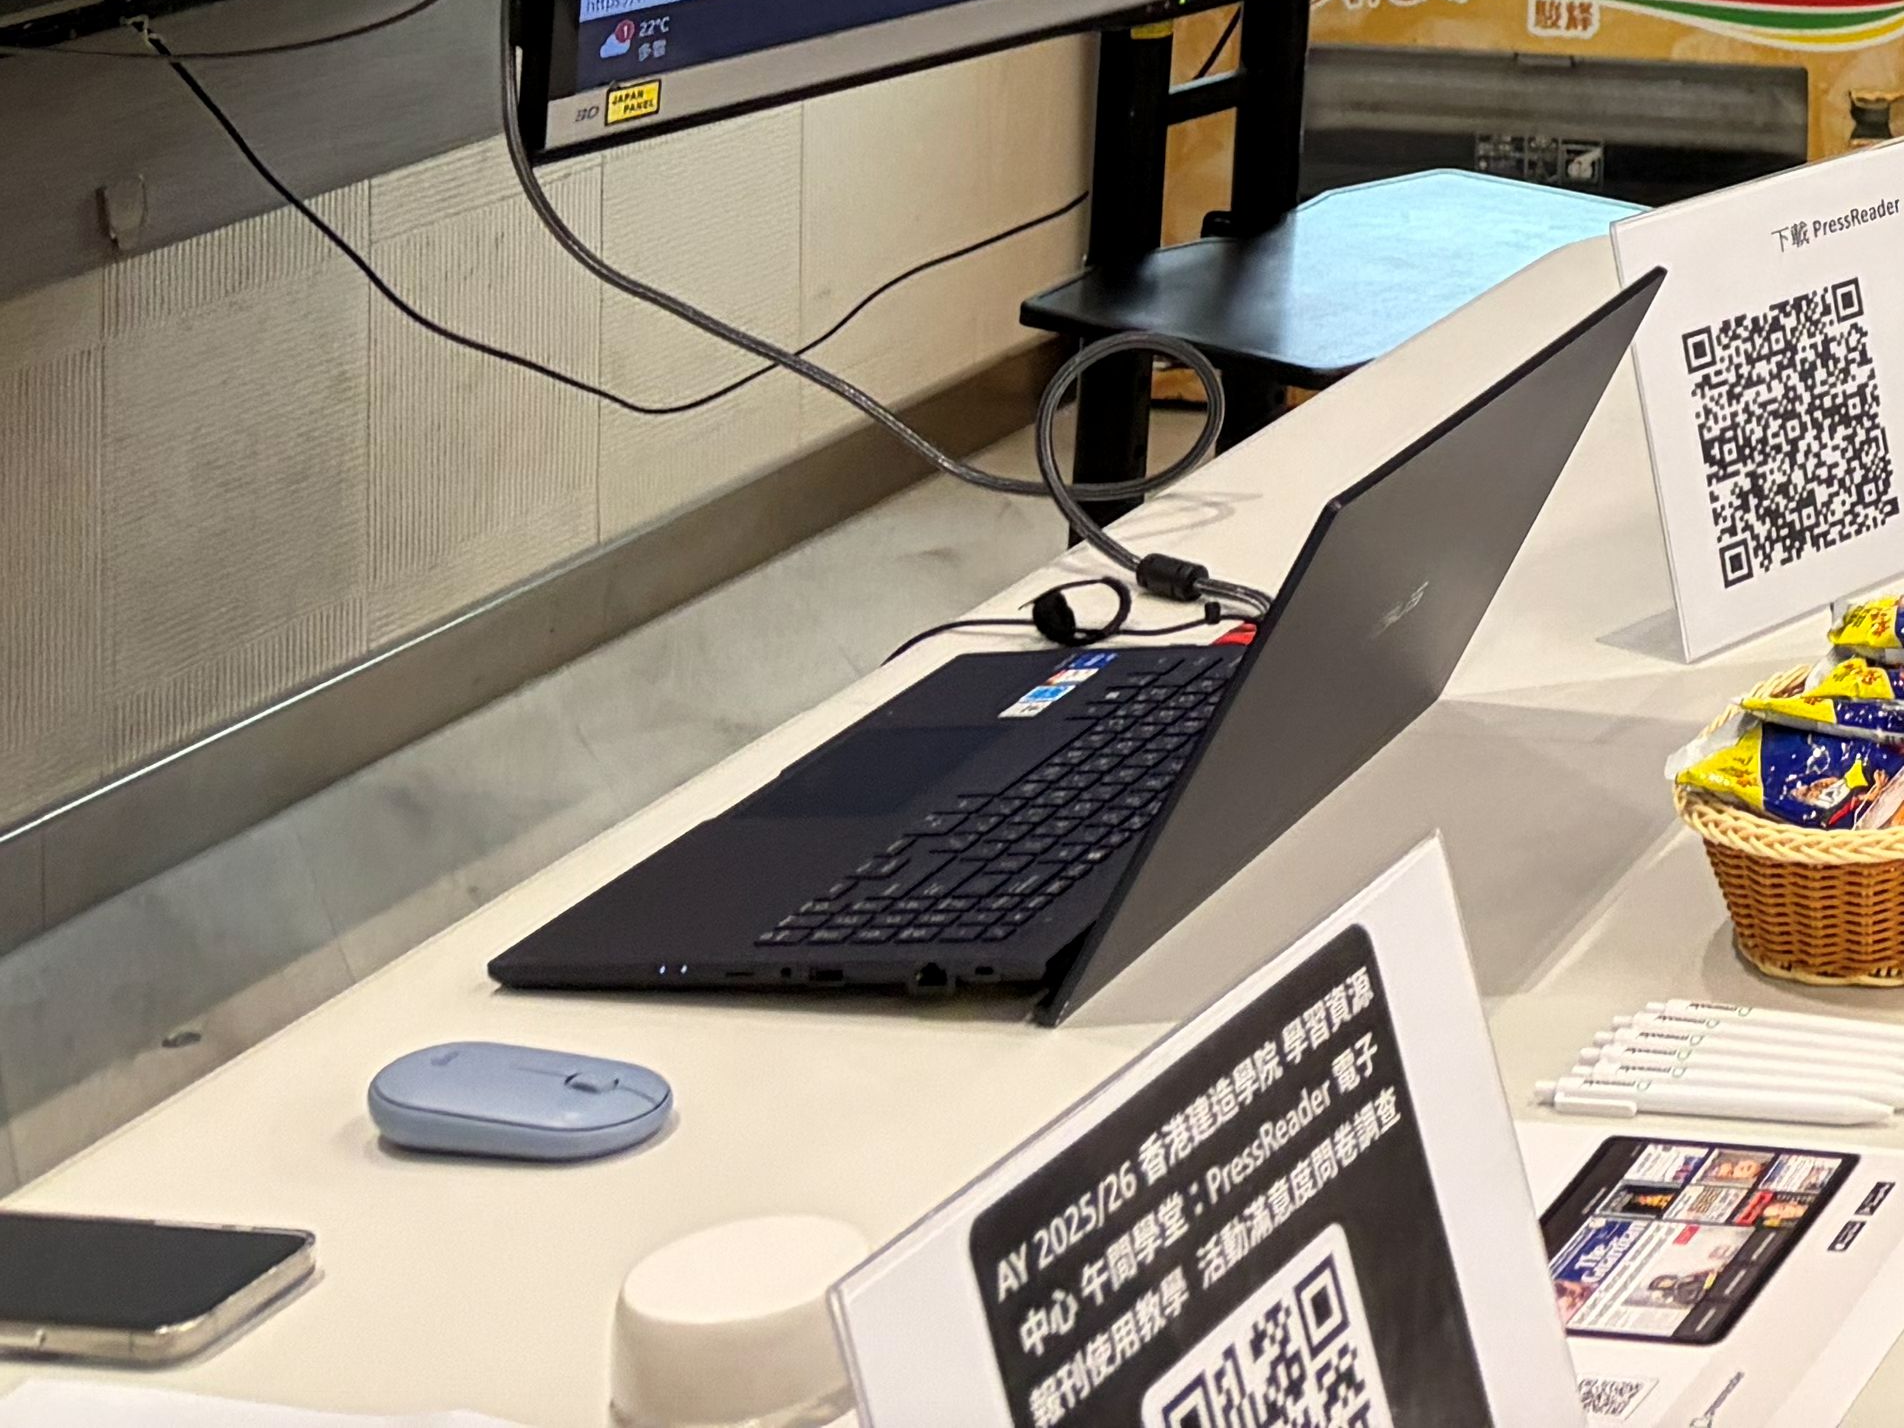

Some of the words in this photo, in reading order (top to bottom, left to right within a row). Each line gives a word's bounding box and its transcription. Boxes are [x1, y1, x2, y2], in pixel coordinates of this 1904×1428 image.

[1771, 222, 1810, 254] 下載
[1812, 196, 1901, 240] PressReader
[996, 1242, 1030, 1304] AY
[1032, 1158, 1139, 1272] 2025/26
[1138, 1039, 1285, 1187] 香港建造學院
[1281, 965, 1375, 1066] 學習資源
[1019, 1287, 1080, 1357] 中心
[1205, 1079, 1332, 1206] PressReader
[1331, 1030, 1379, 1095] 電子
[1028, 1265, 1191, 1428] 報刊使用教學
[1196, 1084, 1402, 1291] 活動滿意度問卷調查
